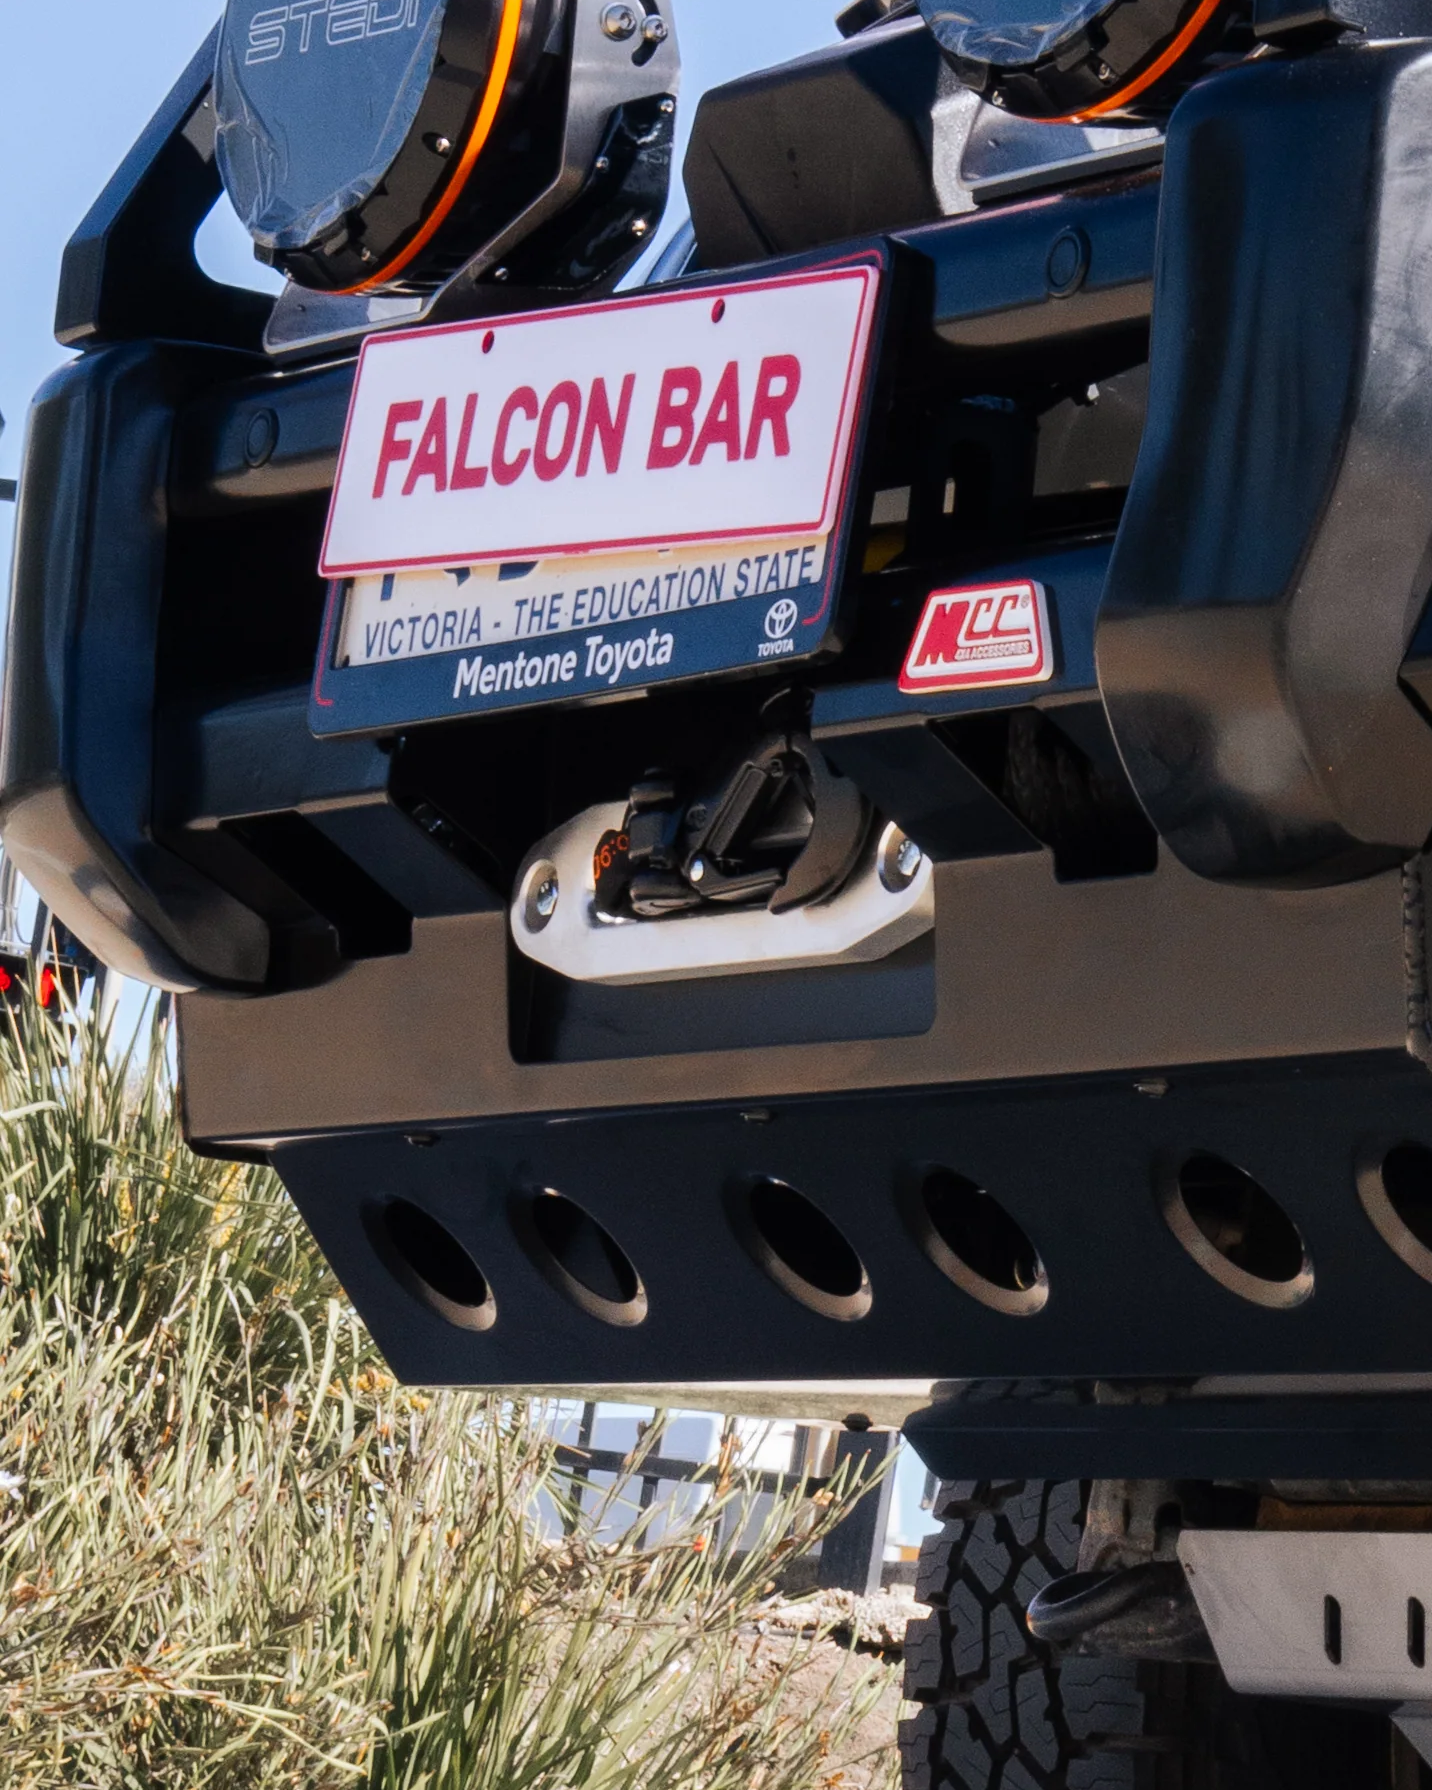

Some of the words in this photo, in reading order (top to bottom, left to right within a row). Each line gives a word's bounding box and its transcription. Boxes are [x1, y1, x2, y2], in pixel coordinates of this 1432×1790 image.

[372, 373, 636, 499] FALCON
[646, 353, 801, 471] BAR
[365, 606, 481, 659] VICTORIA
[515, 592, 564, 636] THE
[571, 563, 726, 626] EDUCATION
[733, 545, 816, 597] STATE
[453, 649, 577, 699] Mentone
[585, 627, 674, 685] Toyota
[757, 639, 794, 657] TOYOTA
[970, 641, 1030, 660] ACCESSORIES
